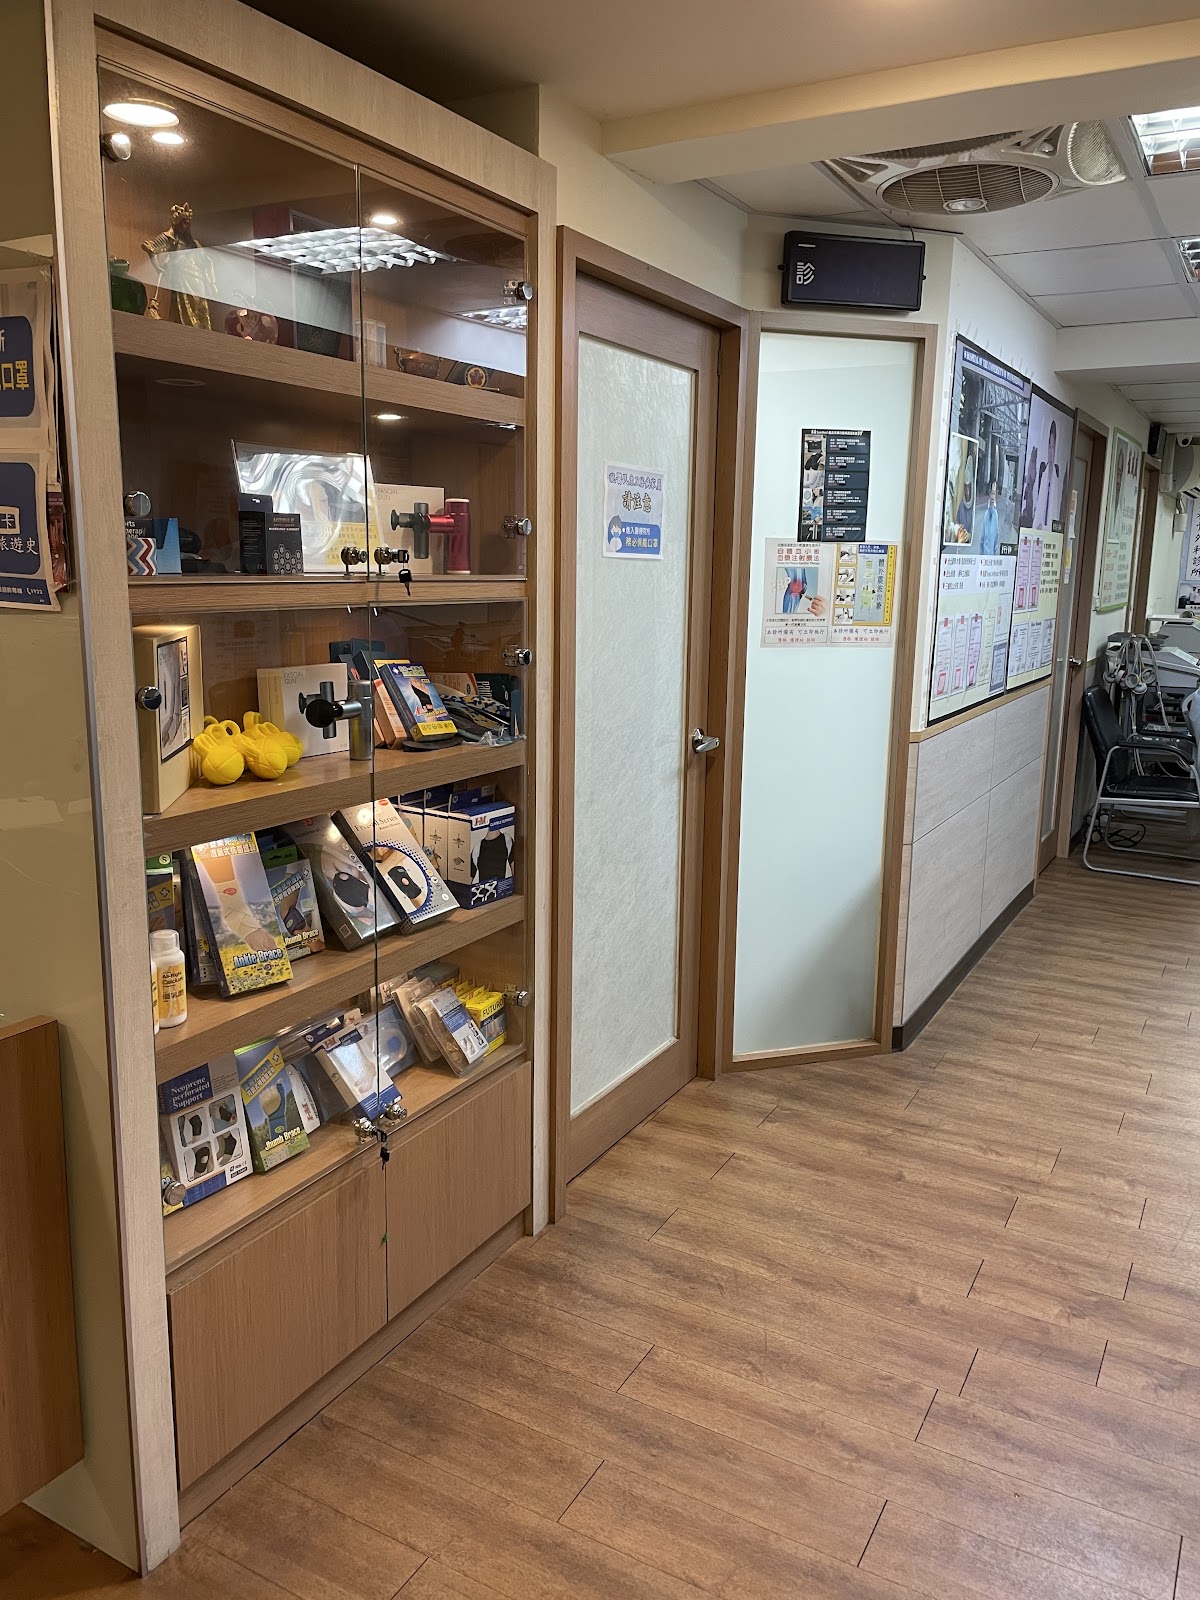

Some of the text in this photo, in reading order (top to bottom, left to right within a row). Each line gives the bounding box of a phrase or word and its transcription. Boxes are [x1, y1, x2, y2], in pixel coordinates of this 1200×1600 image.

[1, 361, 30, 390] 口罩
[622, 491, 652, 513] 請注意
[0, 536, 39, 555] 旅遊史
[302, 928, 319, 940] Brace
[233, 948, 283, 968] Ankle Brace
[482, 998, 505, 1016] FUTURO
[171, 1077, 206, 1096] Neoprene
[173, 1093, 203, 1109] Support
[284, 1126, 301, 1141] Brace
